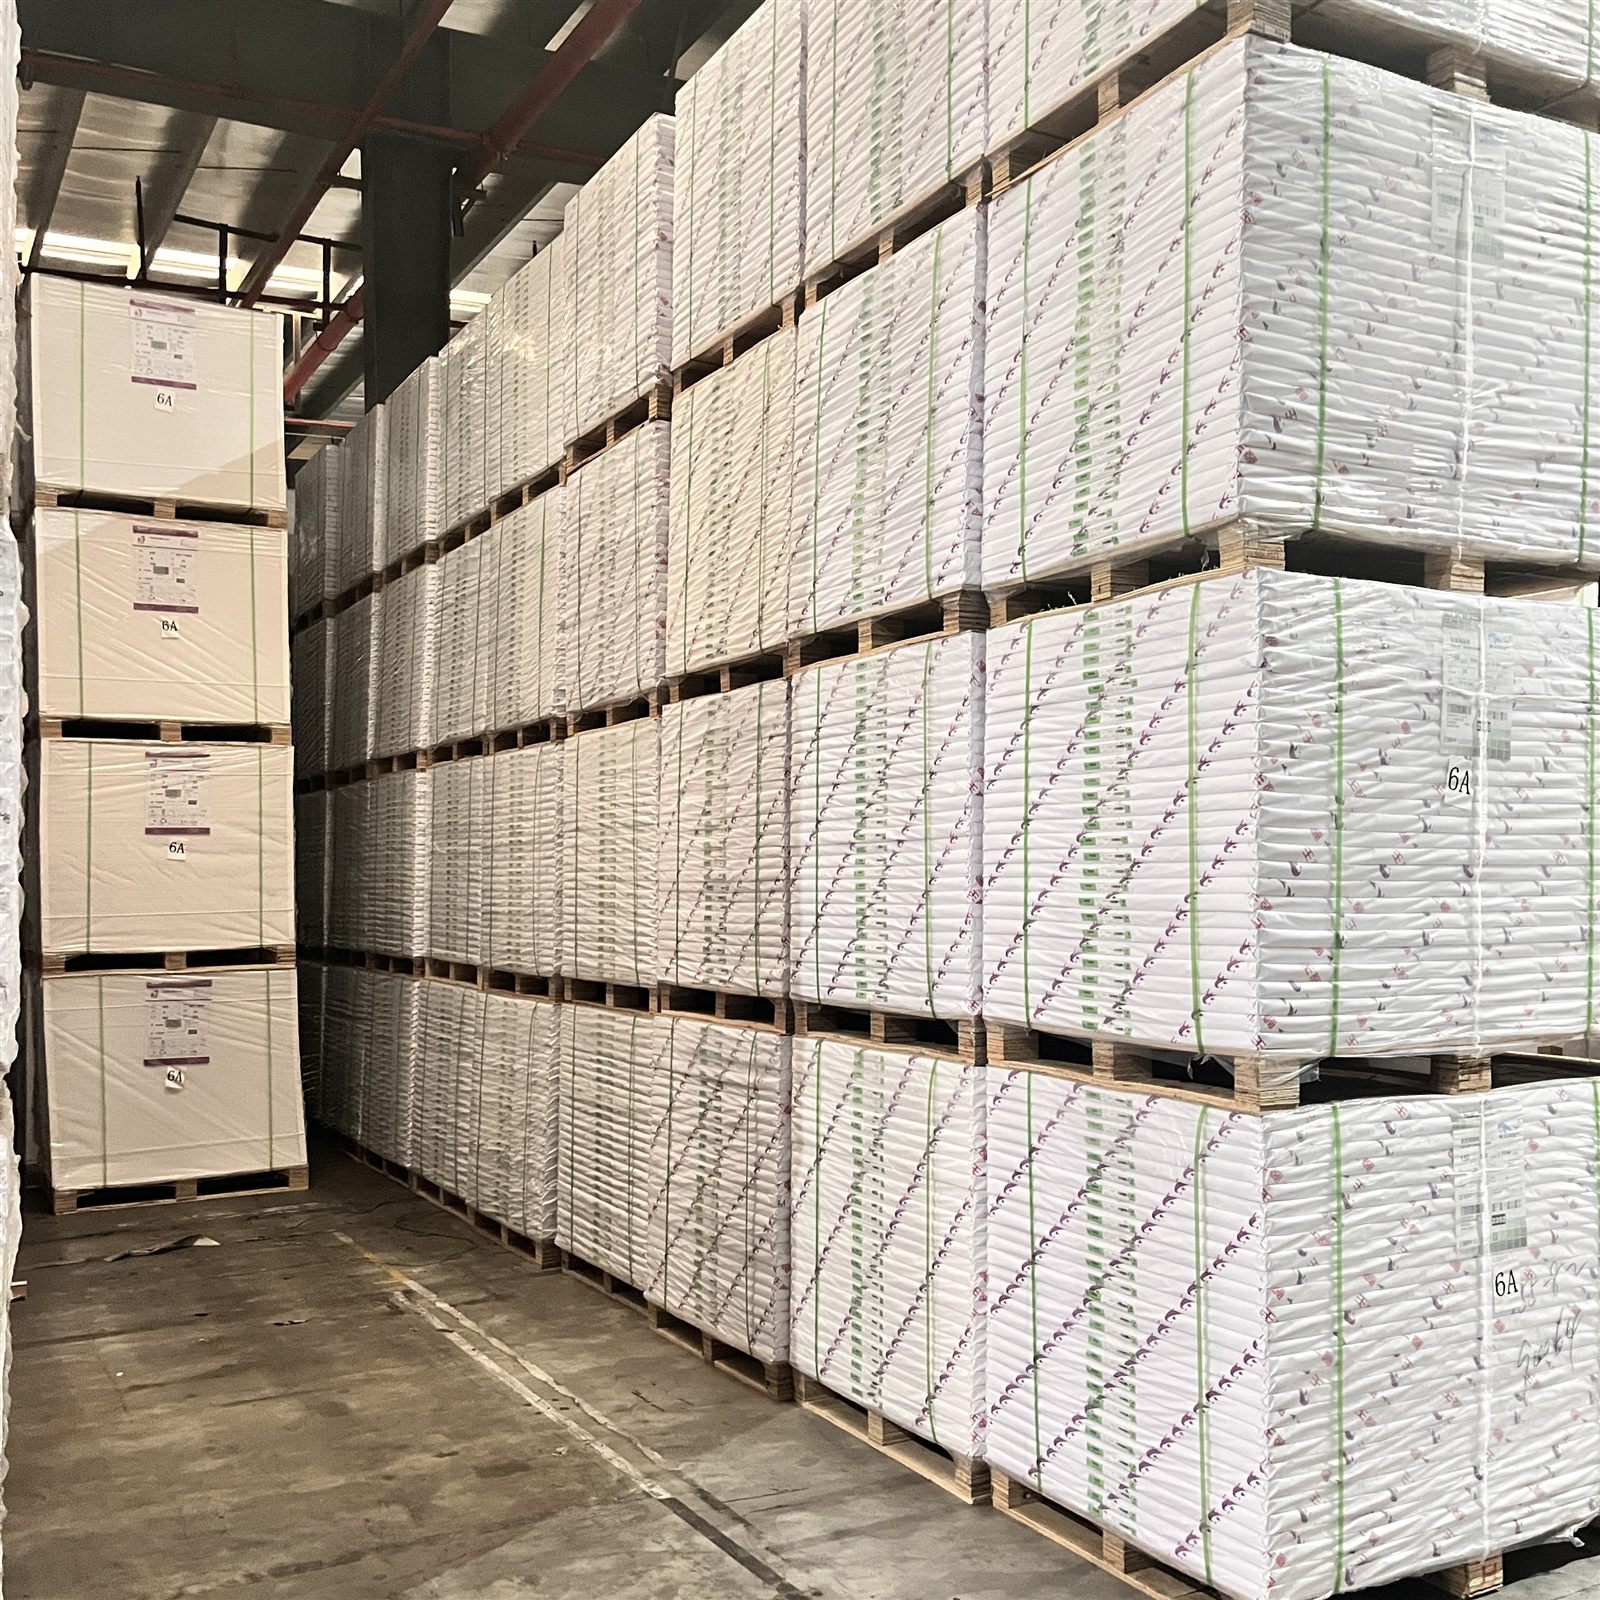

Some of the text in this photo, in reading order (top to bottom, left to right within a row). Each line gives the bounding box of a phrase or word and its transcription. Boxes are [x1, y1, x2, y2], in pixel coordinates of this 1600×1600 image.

[157, 393, 173, 406] 6A
[161, 620, 178, 632] 6A
[1448, 766, 1471, 795] 6A
[169, 842, 185, 853] 6A
[167, 1070, 182, 1083] 6A
[1495, 1270, 1519, 1297] 6A
